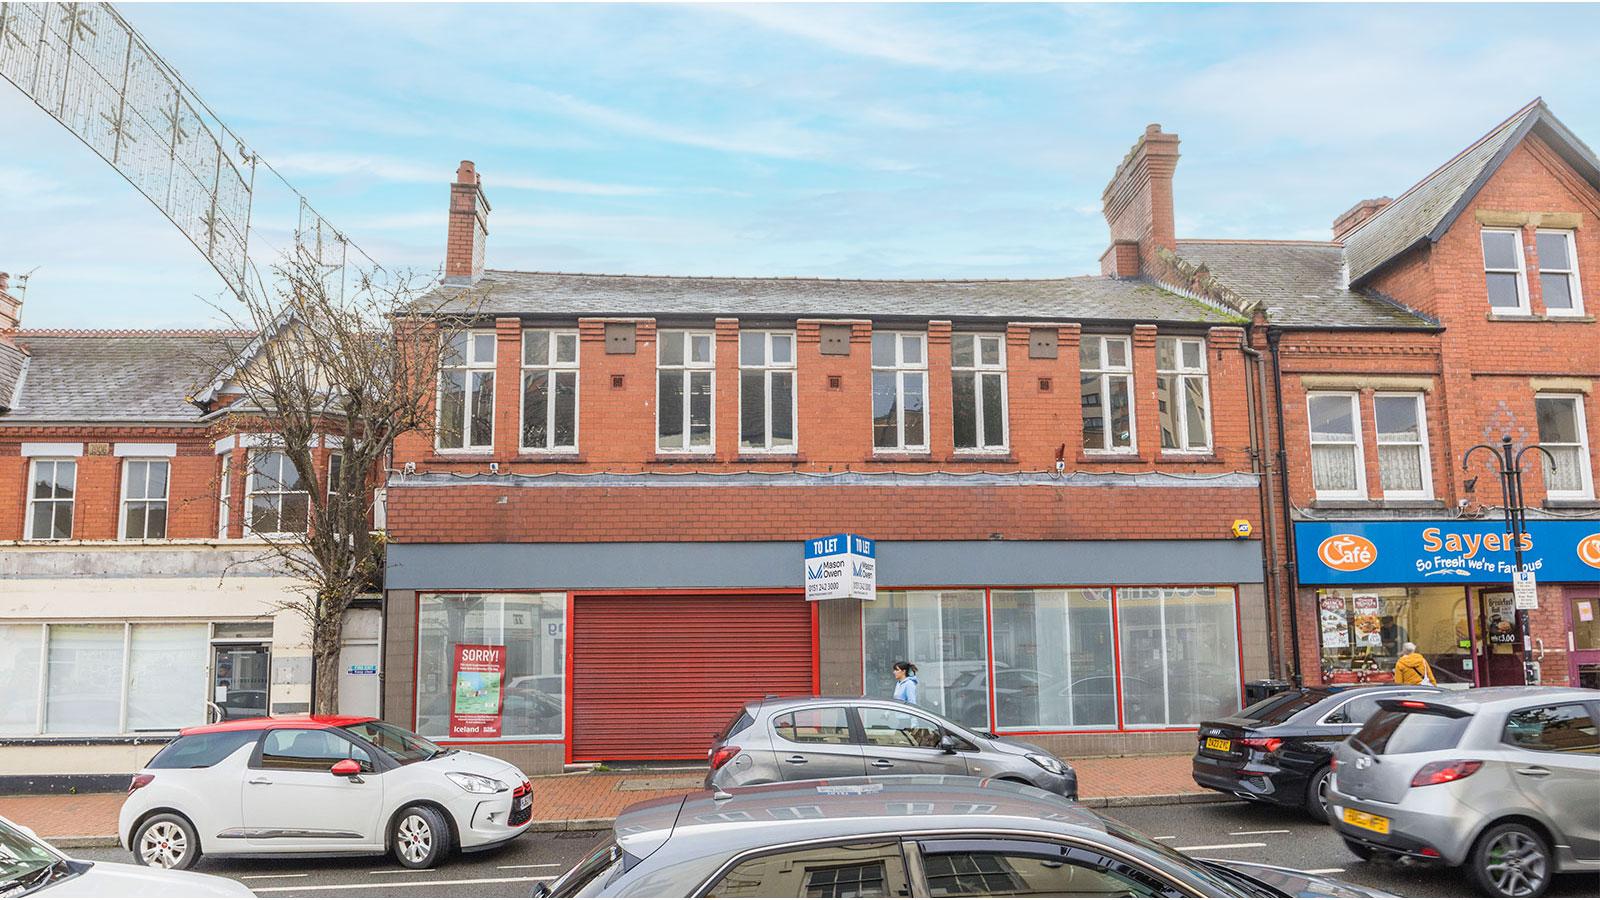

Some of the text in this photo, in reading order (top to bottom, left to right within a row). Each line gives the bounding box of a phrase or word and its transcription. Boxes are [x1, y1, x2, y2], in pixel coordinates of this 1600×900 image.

[813, 538, 838, 555] TO LET
[856, 538, 871, 554] TO LET
[1422, 527, 1533, 559] Sayers
[1324, 541, 1371, 565] Café
[823, 560, 845, 569] Mason
[1416, 559, 1432, 572] So
[1434, 556, 1465, 568] Fresh
[1468, 557, 1495, 572] we're
[823, 569, 842, 578] Owen
[808, 582, 839, 592] 0151 242 3000
[462, 649, 499, 662] SORRY!
